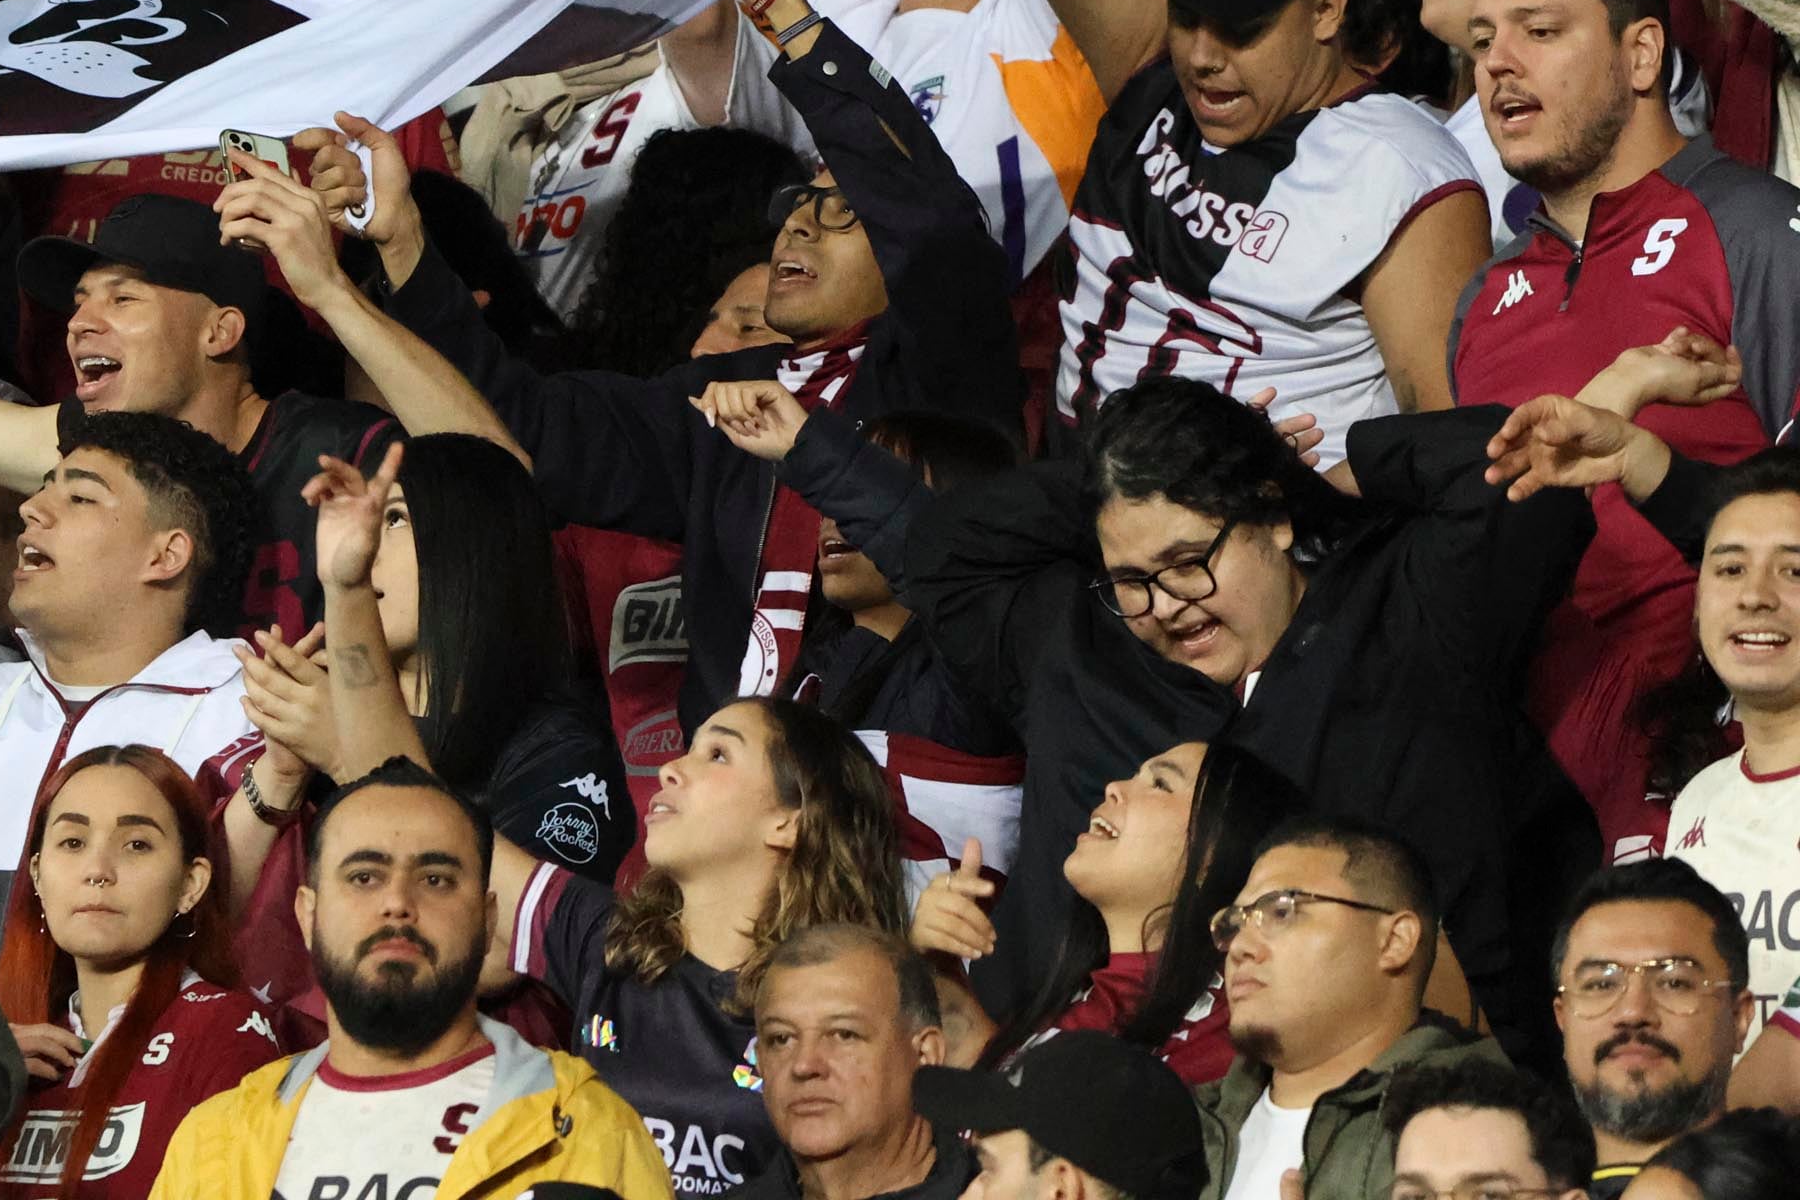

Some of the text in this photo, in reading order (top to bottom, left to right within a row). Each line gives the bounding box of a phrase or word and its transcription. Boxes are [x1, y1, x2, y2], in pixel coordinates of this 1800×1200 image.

[580, 91, 643, 170] S
[1630, 217, 1689, 277] S
[536, 808, 595, 847] Johnny
[142, 1032, 176, 1066] S
